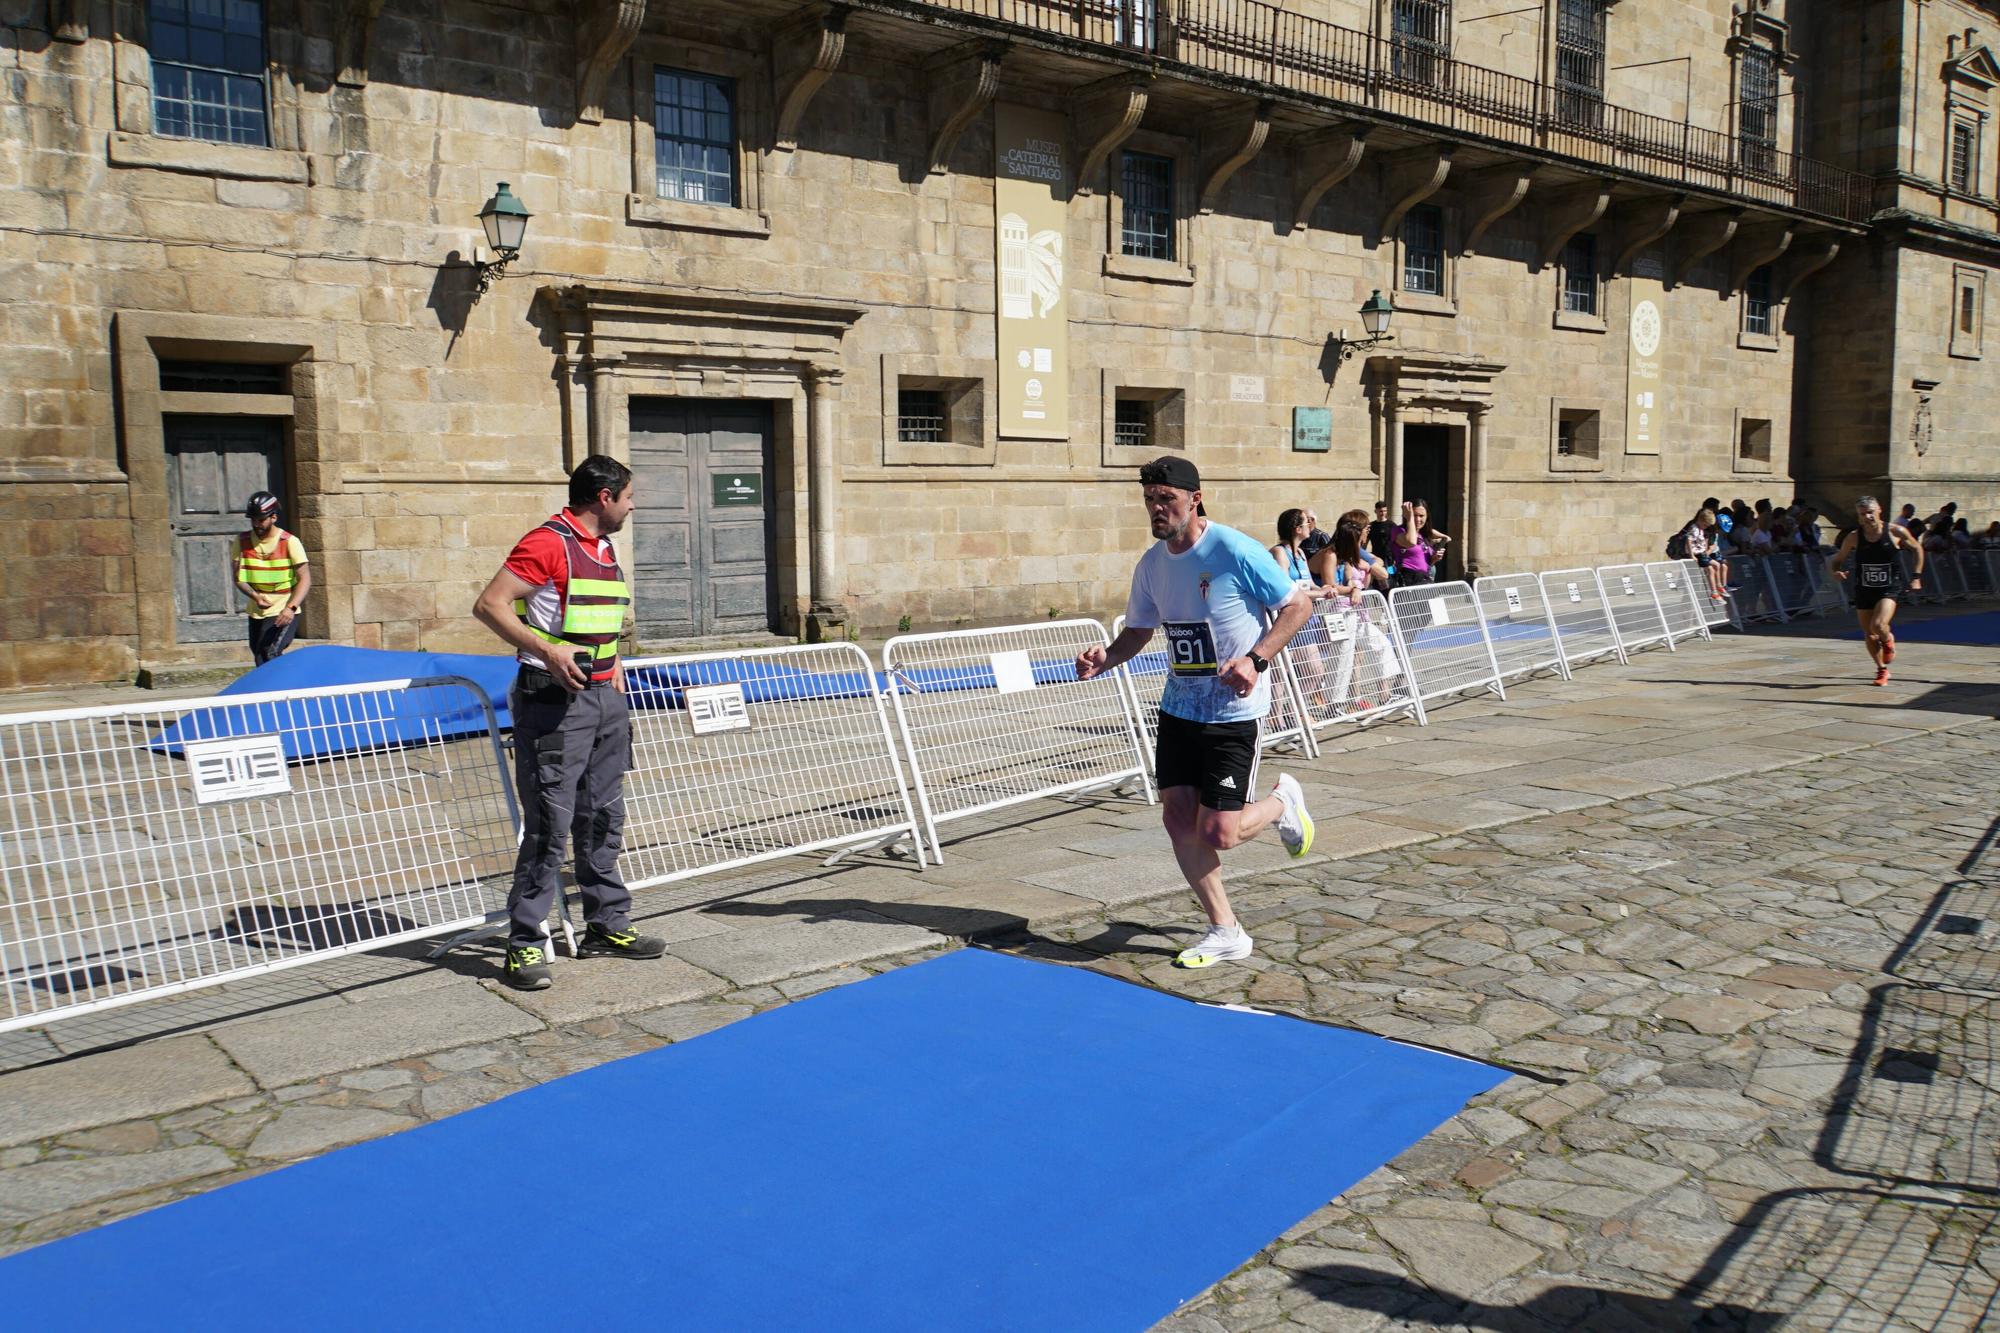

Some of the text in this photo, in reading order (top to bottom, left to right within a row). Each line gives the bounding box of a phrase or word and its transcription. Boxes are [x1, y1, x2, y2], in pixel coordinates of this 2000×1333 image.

[1026, 139, 1060, 155] MUSEO
[1008, 149, 1061, 168] CATEDRAL
[1008, 162, 1061, 180] SANTIAGO
[1865, 571, 1887, 582] 150
[1168, 639, 1205, 664] 191
